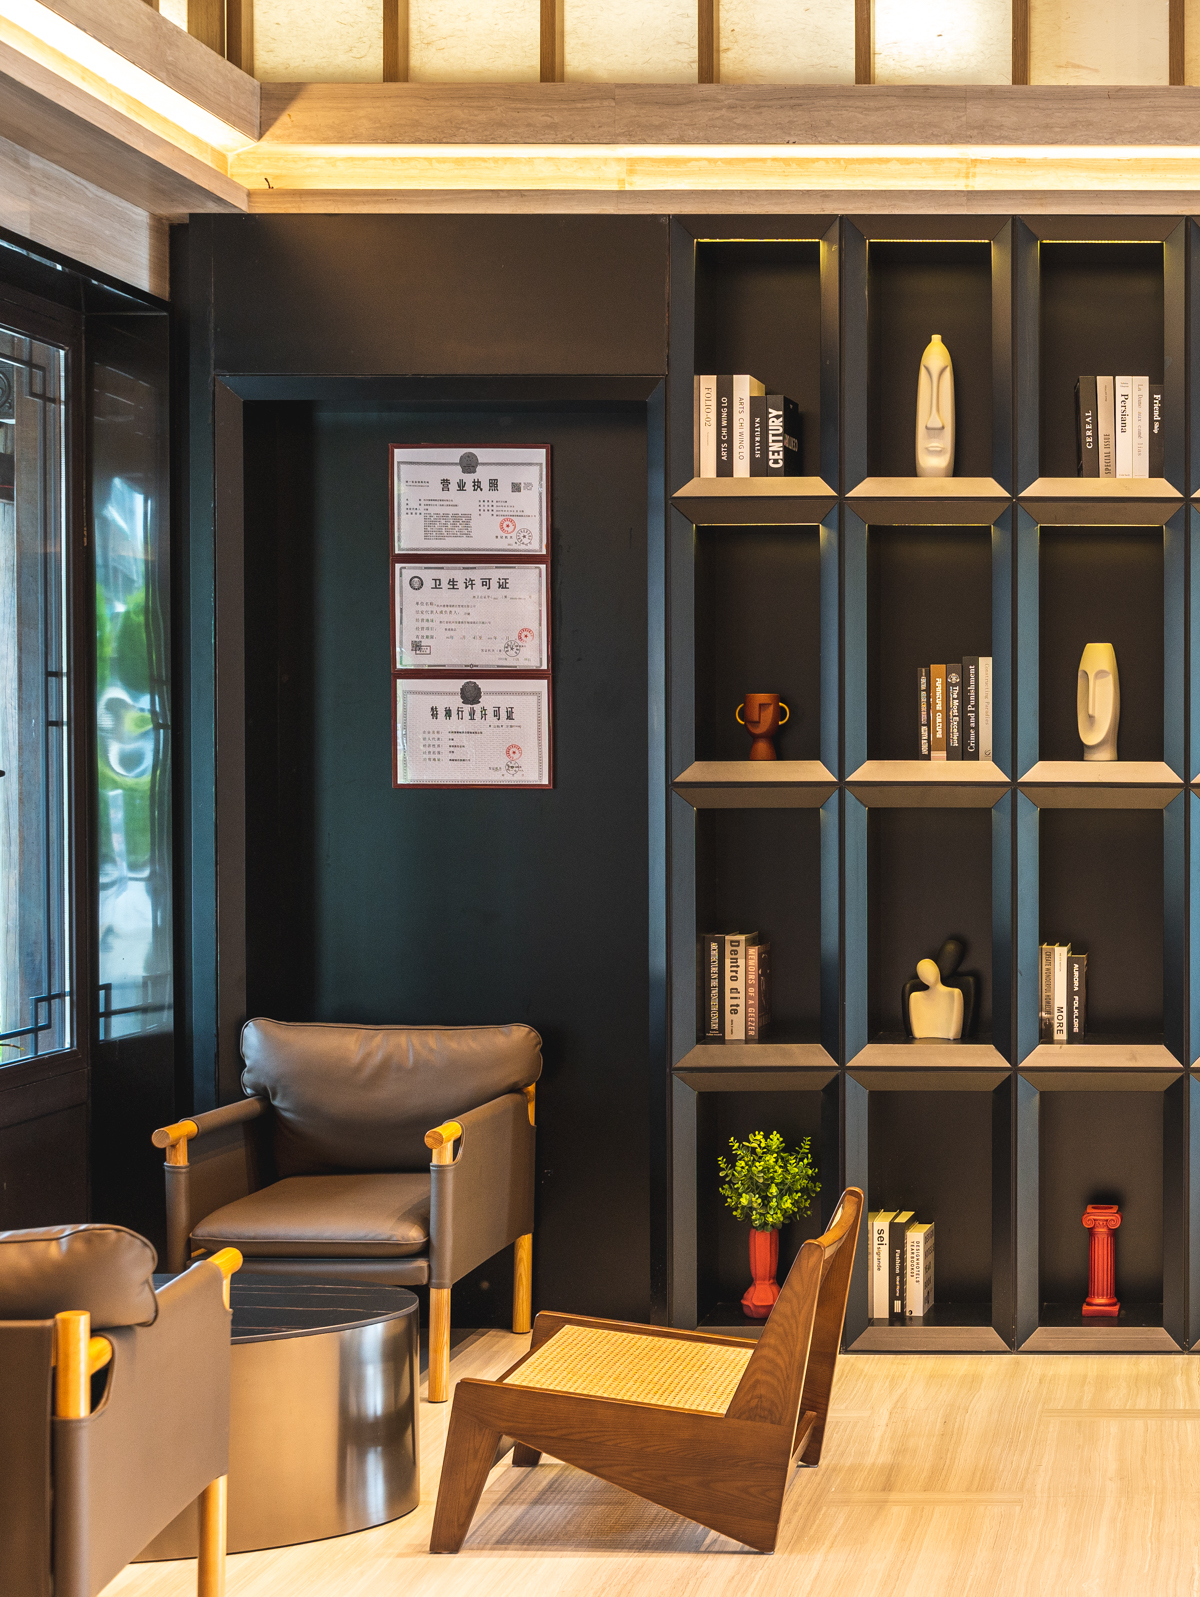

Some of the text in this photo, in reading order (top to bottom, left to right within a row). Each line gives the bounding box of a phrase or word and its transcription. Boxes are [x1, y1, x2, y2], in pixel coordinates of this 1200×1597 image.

[721, 397, 727, 407] LO
[1121, 394, 1129, 433] Persiana
[1085, 411, 1093, 448] CEREAL
[769, 408, 783, 468] CENTURY
[739, 452, 744, 460] LO
[440, 478, 499, 491] 营业执照
[431, 578, 509, 590] 卫生许可证
[430, 706, 515, 720] 特种行业许可证
[730, 940, 740, 1015] Dentro di te
[748, 988, 755, 996] OF
[877, 1229, 886, 1245] sei
